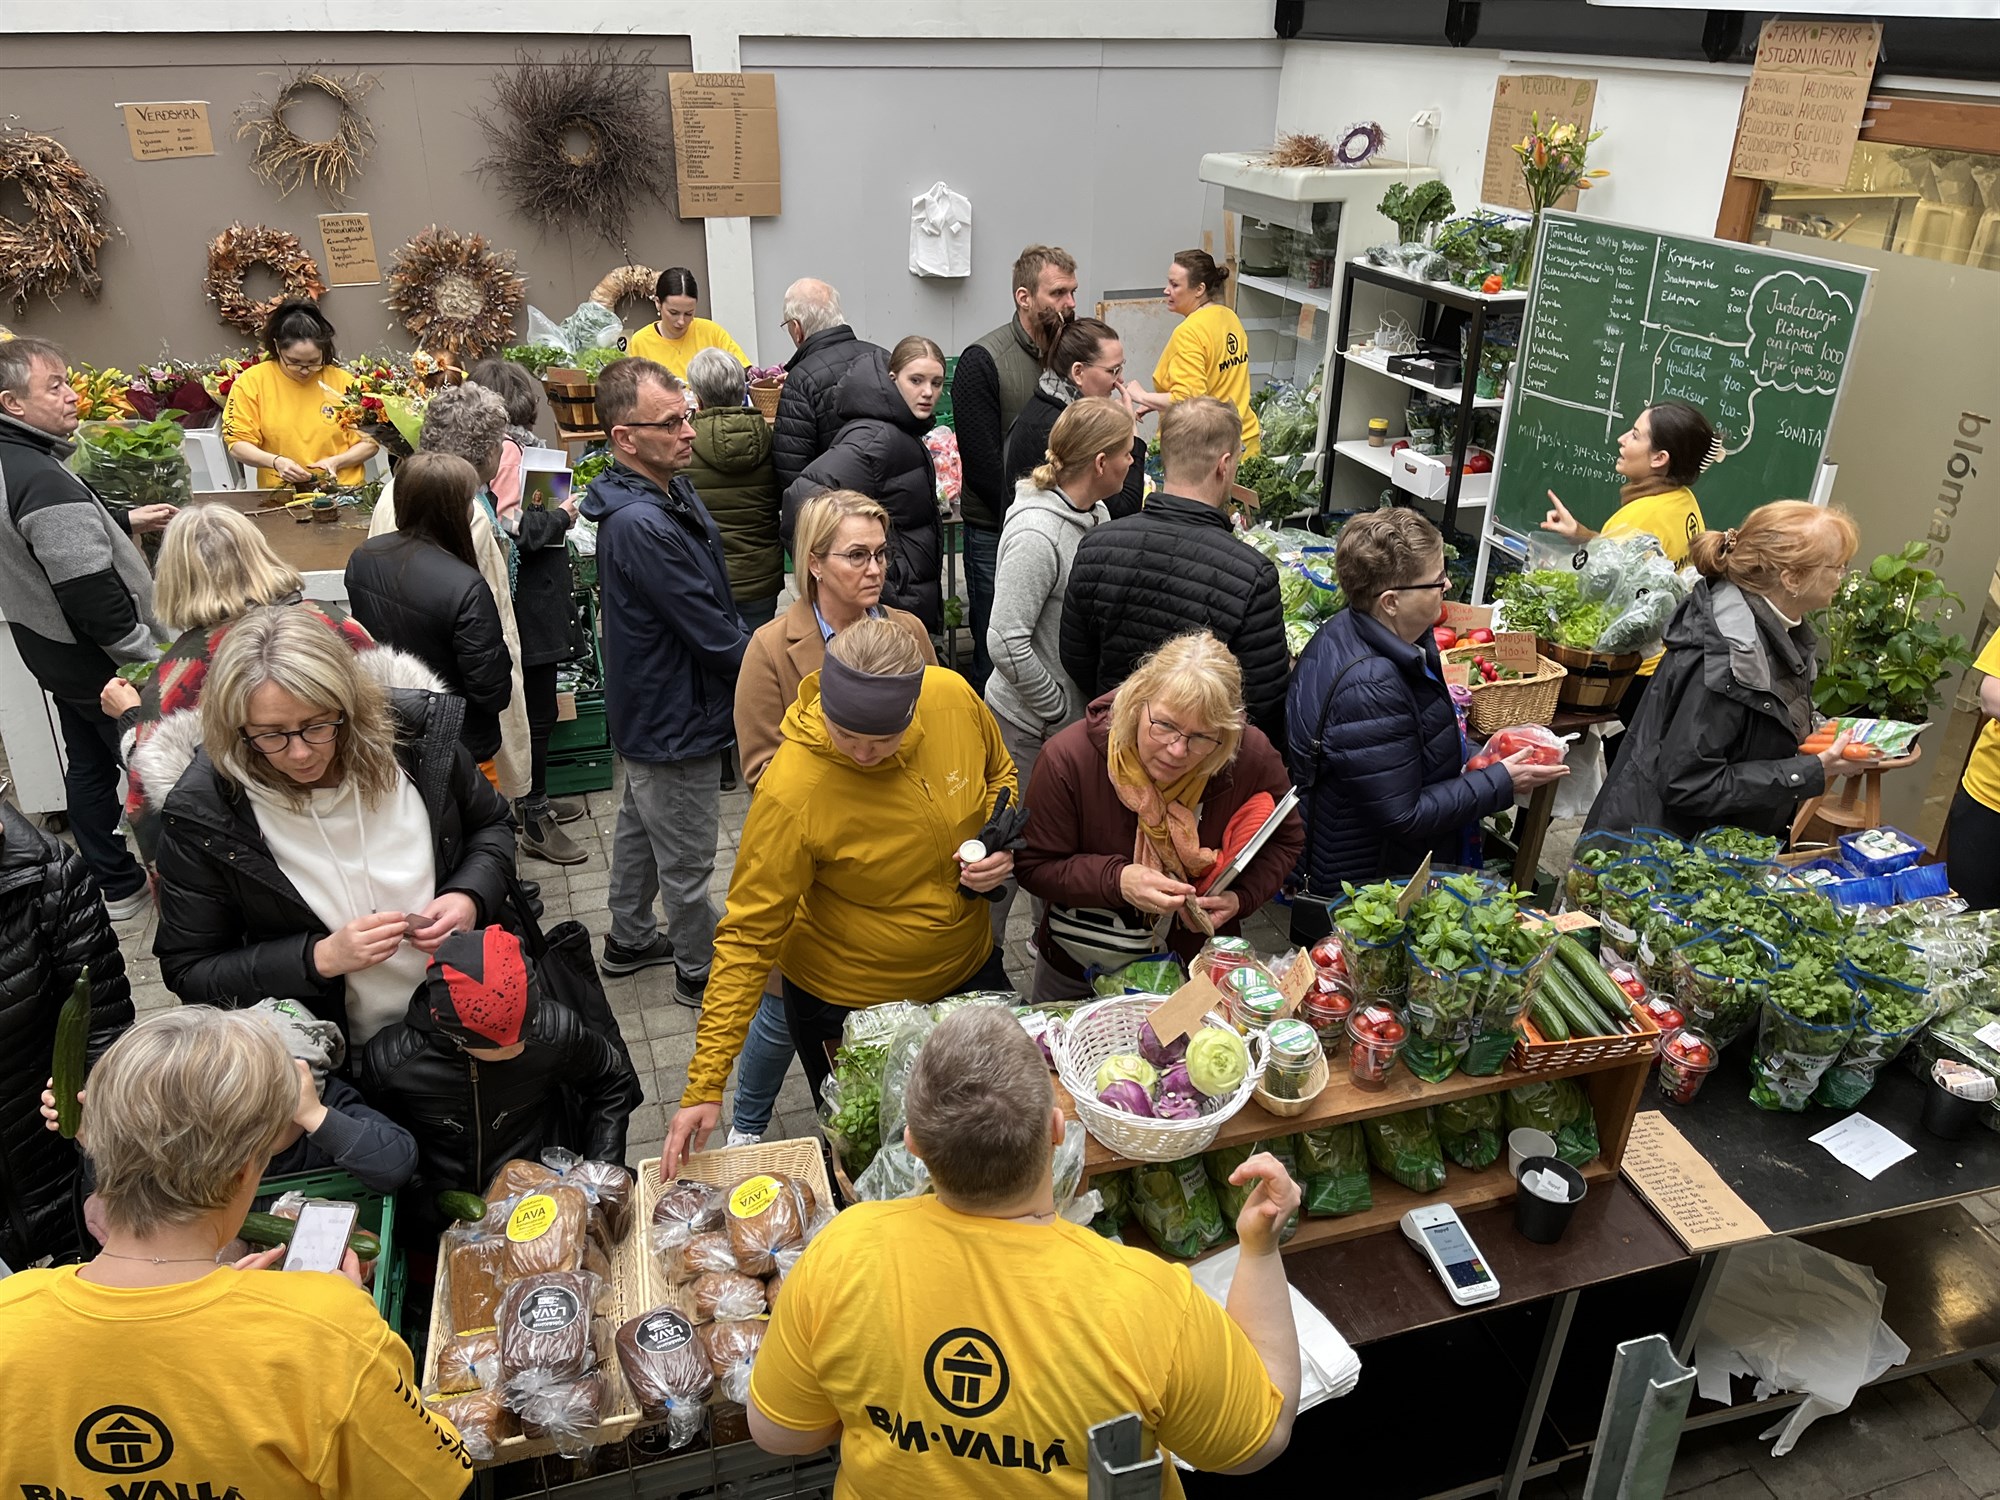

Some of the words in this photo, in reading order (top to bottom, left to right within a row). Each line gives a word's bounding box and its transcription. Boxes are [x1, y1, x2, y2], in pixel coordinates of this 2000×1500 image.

[1772, 25, 1812, 44] TAKK
[1819, 26, 1862, 44] FYRIR
[1821, 341, 1844, 364] 1000
[739, 1187, 769, 1208] LAVA
[516, 1207, 546, 1224] LAVA
[531, 1306, 567, 1319] LAVA
[649, 1324, 684, 1343] LAVA
